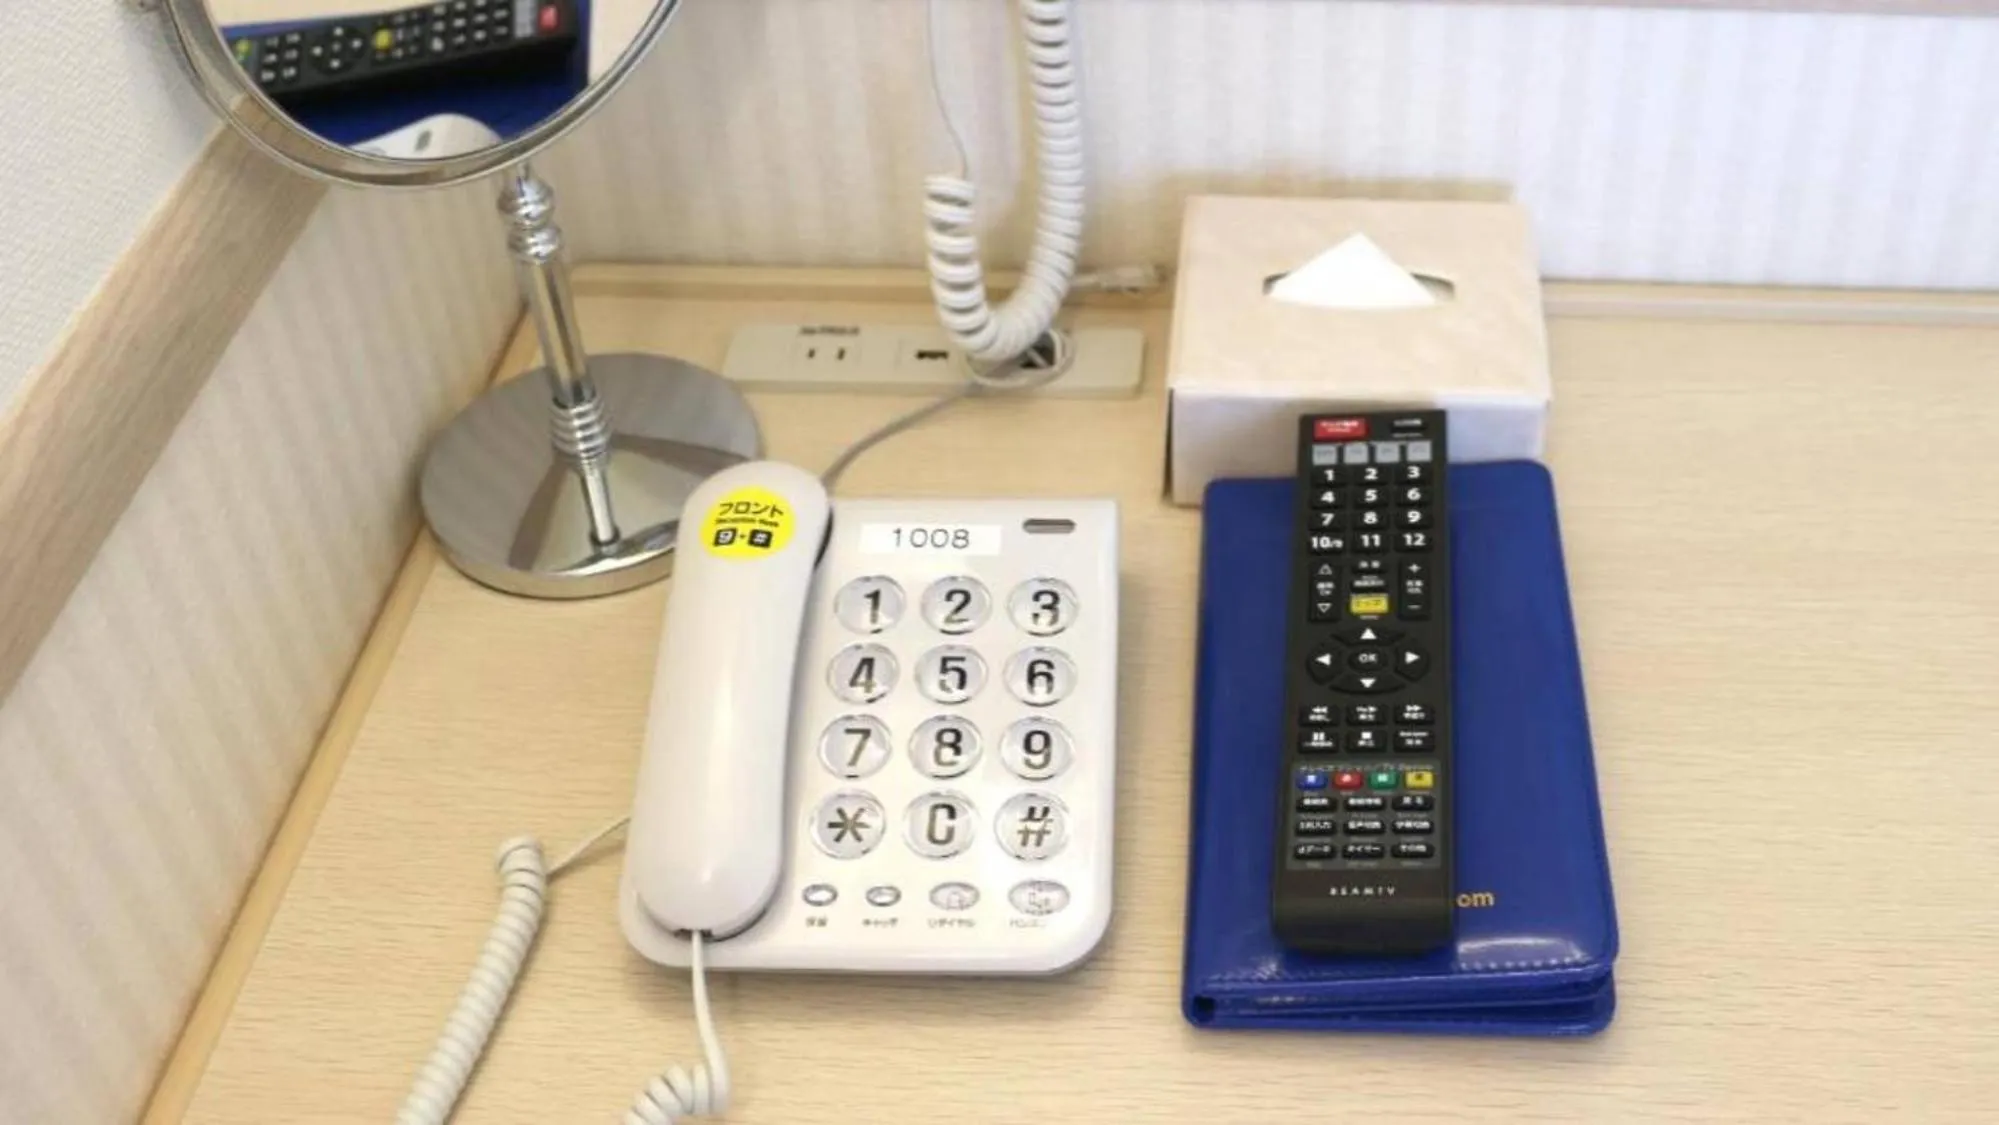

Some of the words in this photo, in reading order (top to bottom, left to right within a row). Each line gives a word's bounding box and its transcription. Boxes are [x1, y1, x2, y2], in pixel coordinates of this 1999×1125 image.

[1324, 469, 1335, 482] 1
[1364, 467, 1379, 480] 2
[1407, 465, 1421, 478] 3
[1320, 491, 1335, 503] 4
[1364, 489, 1378, 502] 5
[1406, 488, 1421, 500] 6
[719, 501, 784, 518] フロント
[1363, 511, 1378, 524] 8
[1406, 510, 1421, 523] 9
[1321, 512, 1335, 526] 7
[893, 527, 971, 549] 1008
[1361, 534, 1381, 547] 11
[1404, 533, 1426, 546] 12
[863, 588, 882, 625] 1
[943, 588, 972, 624] 2
[1032, 588, 1061, 628] 3
[1358, 653, 1378, 663] OK
[849, 656, 876, 694] 4
[938, 655, 968, 694] 5
[1026, 658, 1056, 697] 6
[844, 727, 873, 767] 7
[933, 727, 964, 767] 8
[1022, 729, 1054, 770] 9
[926, 803, 957, 846] C
[1016, 806, 1054, 848] #
